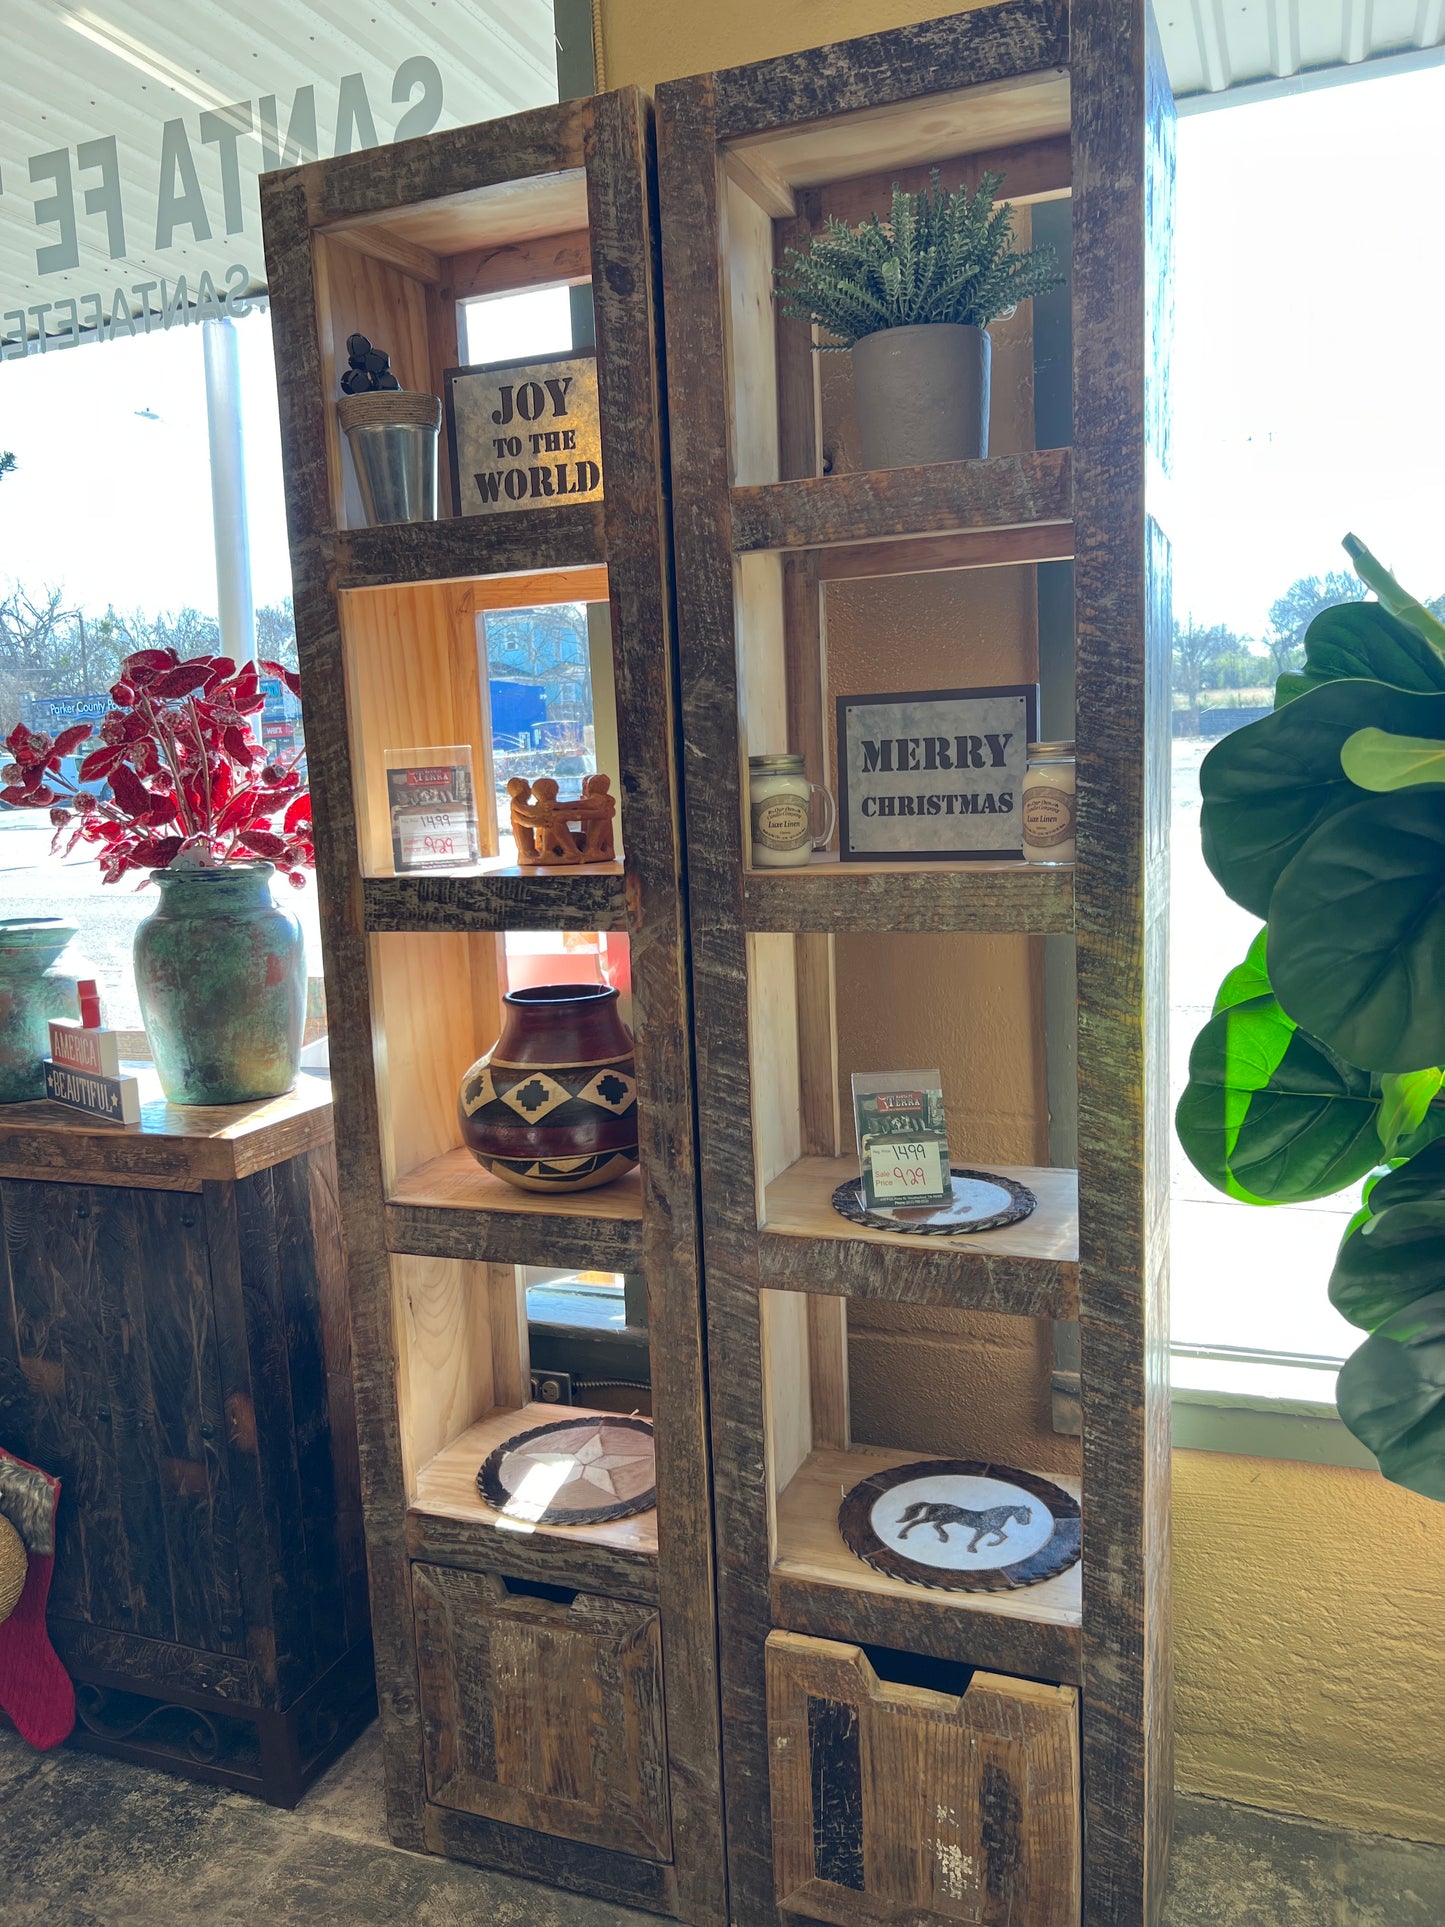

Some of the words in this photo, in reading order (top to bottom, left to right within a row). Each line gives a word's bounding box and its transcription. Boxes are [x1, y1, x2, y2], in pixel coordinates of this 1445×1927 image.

[491, 377, 573, 425] JOY
[493, 436, 522, 458] TO
[529, 429, 576, 454] THE
[474, 460, 601, 504] WORLD
[50, 703, 75, 715] Parker
[77, 701, 105, 716] County
[861, 733, 1013, 773] MERRY
[861, 792, 1013, 818] CHRISTMAS
[421, 815, 451, 829] 1499
[424, 836, 454, 855] 929
[54, 1031, 97, 1067] AMERICA
[53, 1070, 113, 1113] BEAUTIFUL
[892, 1144, 926, 1160] 1499
[894, 1167, 926, 1186] 929
